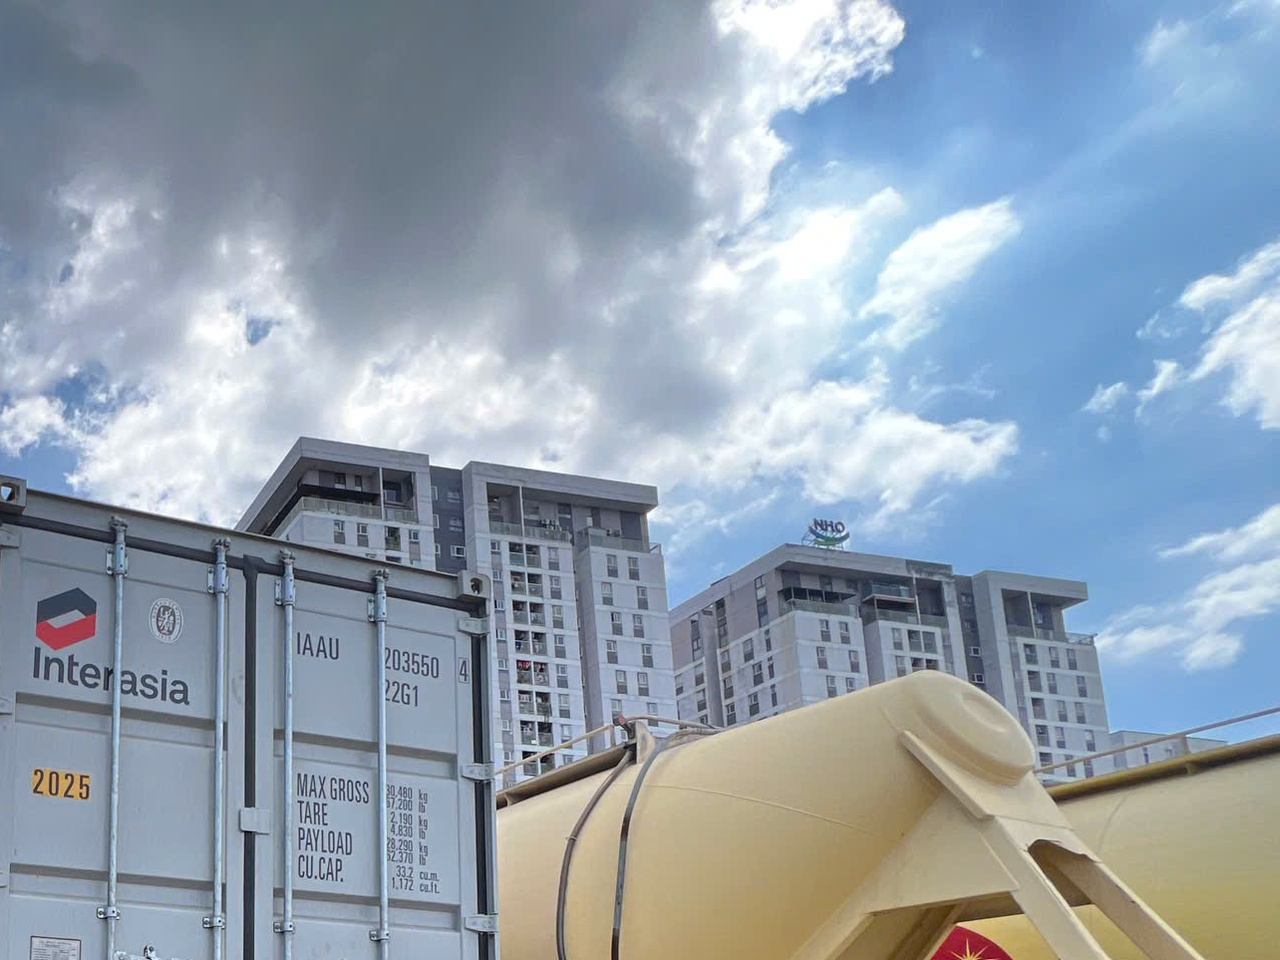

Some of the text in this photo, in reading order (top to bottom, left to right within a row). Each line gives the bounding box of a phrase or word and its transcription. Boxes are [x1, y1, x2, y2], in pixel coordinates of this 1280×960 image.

[297, 632, 340, 660] IAAU
[33, 645, 190, 705] Interasia
[385, 647, 469, 682] 203550 4
[385, 679, 418, 707] 22G1
[33, 769, 90, 799] 2025
[297, 773, 369, 804] MAX GROSS
[419, 789, 428, 804] kg
[297, 800, 328, 826] TARE
[419, 800, 426, 813] lb
[419, 816, 428, 830] kg
[419, 827, 426, 839] lb
[298, 827, 353, 855] PAYLOAD
[419, 842, 428, 856] kg
[298, 855, 344, 882] CU.CAP.
[419, 854, 426, 865] lb
